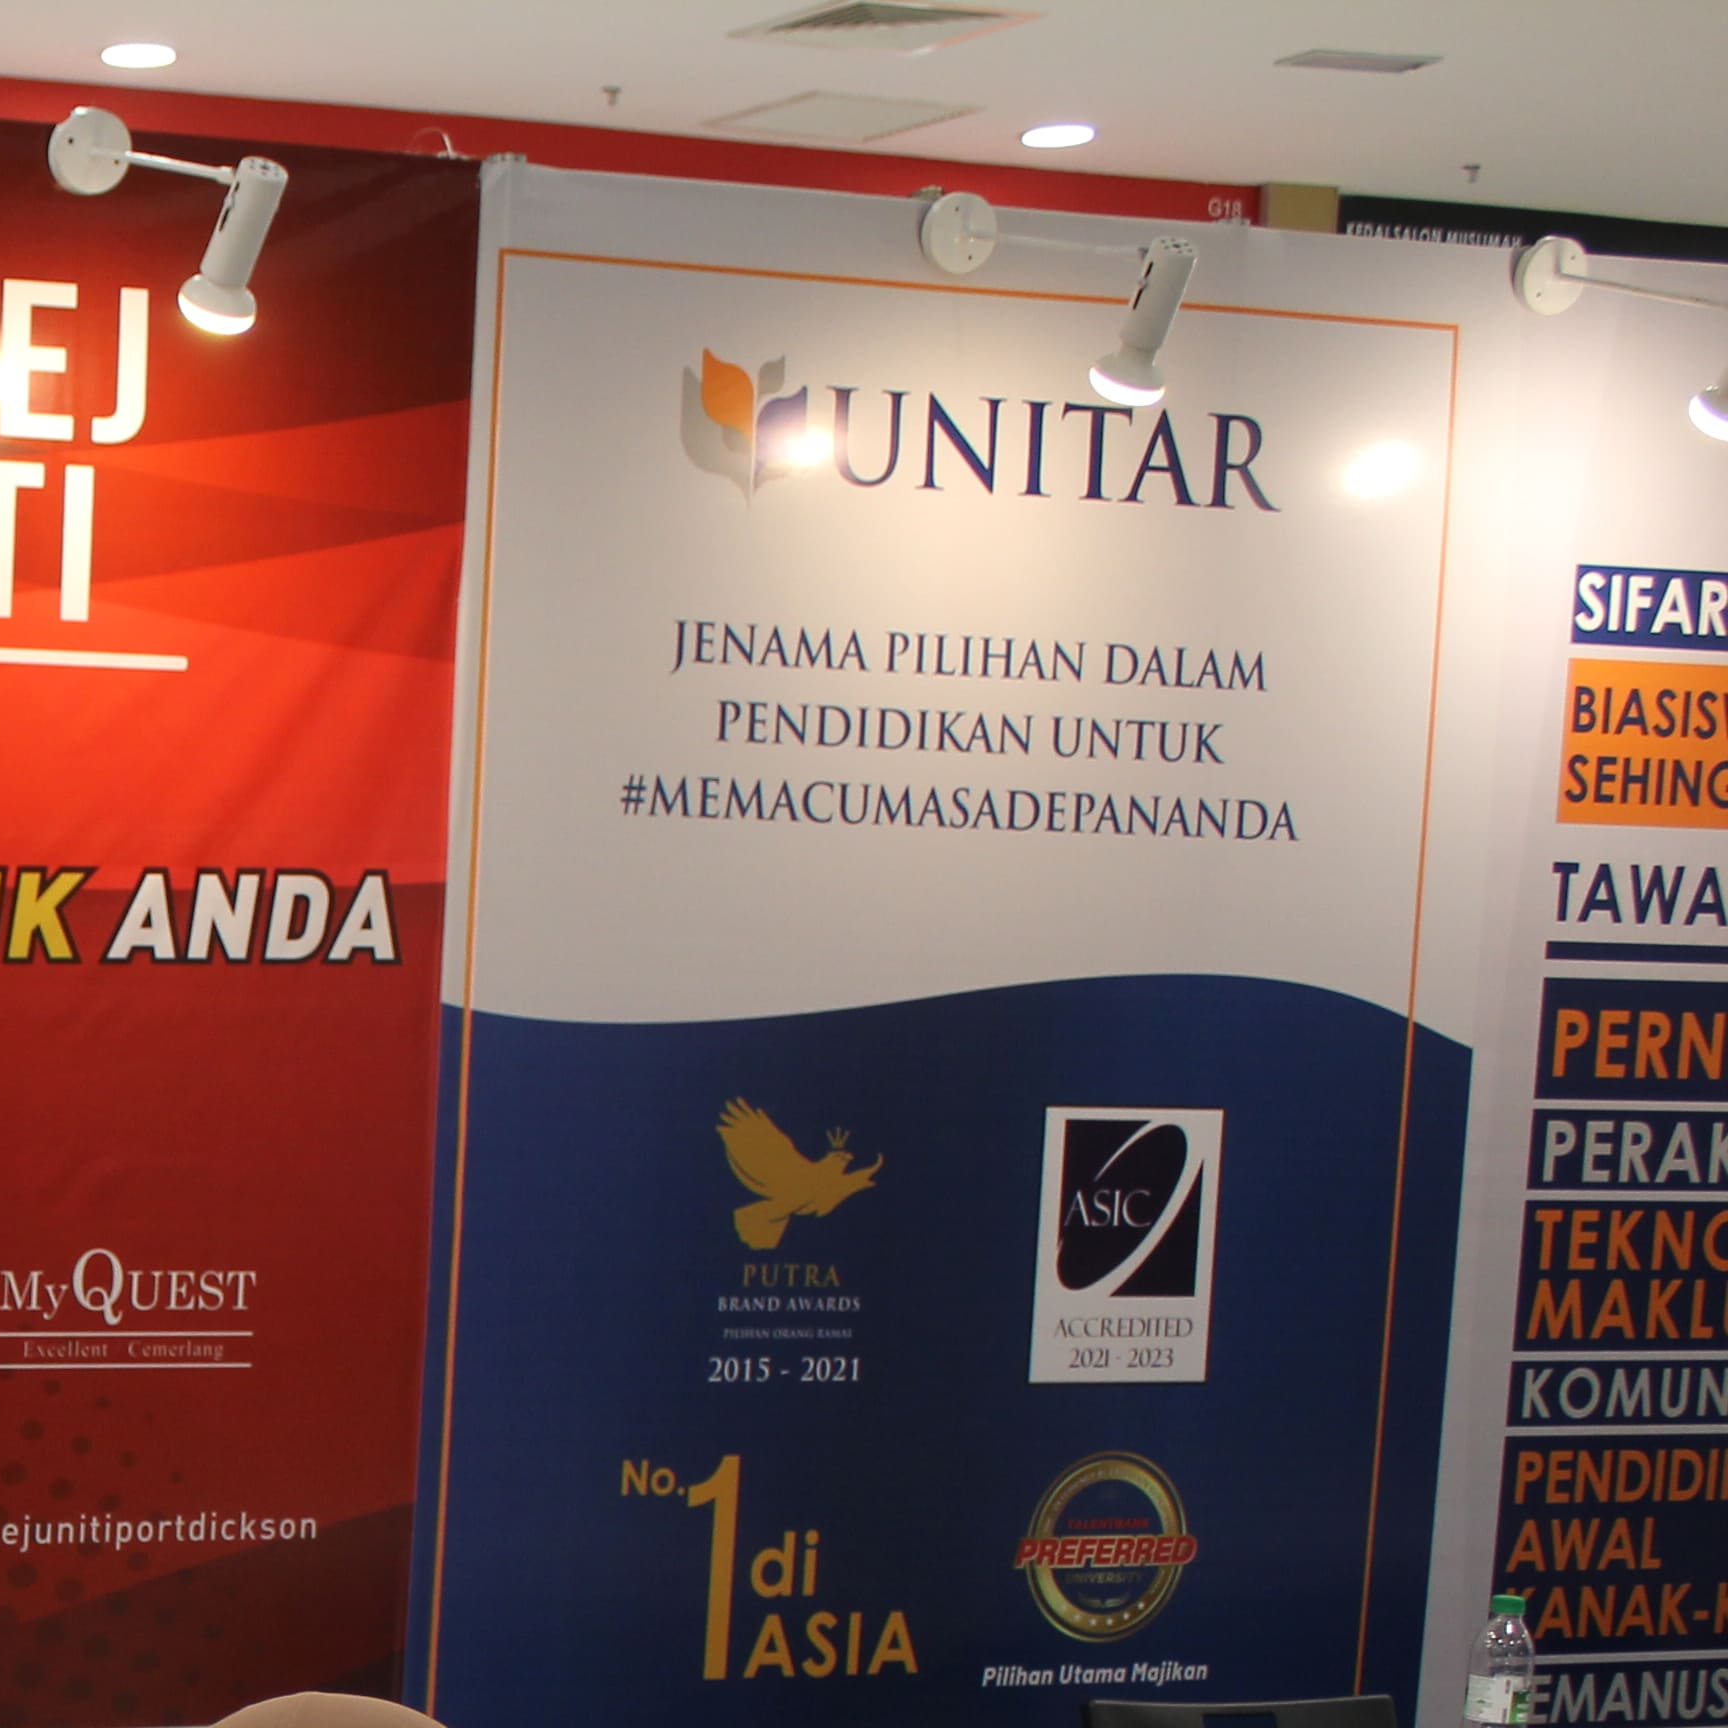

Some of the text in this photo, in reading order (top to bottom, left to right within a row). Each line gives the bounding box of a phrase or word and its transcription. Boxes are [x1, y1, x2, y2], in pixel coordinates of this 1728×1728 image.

[827, 384, 1283, 513] UNITAR
[1574, 571, 1728, 637] SIFAR
[673, 620, 1265, 692] JENAMA PILIHAN DALAM
[717, 700, 1224, 764] PENDIDIKAN UNTUK
[1572, 686, 1728, 739] BIASIS
[620, 774, 1298, 841] #MEMACUMASADEPANANDA
[98, 868, 402, 965] ANDA
[1064, 1188, 1152, 1232] ASIC
[742, 1264, 840, 1287] PUTRA
[718, 1297, 861, 1312] BRAND AWARDS
[1053, 1316, 1194, 1341] ACCREDITED
[1526, 1279, 1728, 1339] MAKL
[22, 1338, 226, 1363] Excellent Cemerlang
[708, 1357, 861, 1382] 2015 2021
[1068, 1346, 1174, 1370] 2021 2023
[618, 1453, 742, 1681] No. 1
[750, 1530, 819, 1600] di
[1014, 1535, 1198, 1568] PREFERRED
[1505, 1517, 1662, 1573] AWAL
[744, 1610, 919, 1681] ASIA
[981, 1658, 1209, 1688] Pilihan Utama Majikan
